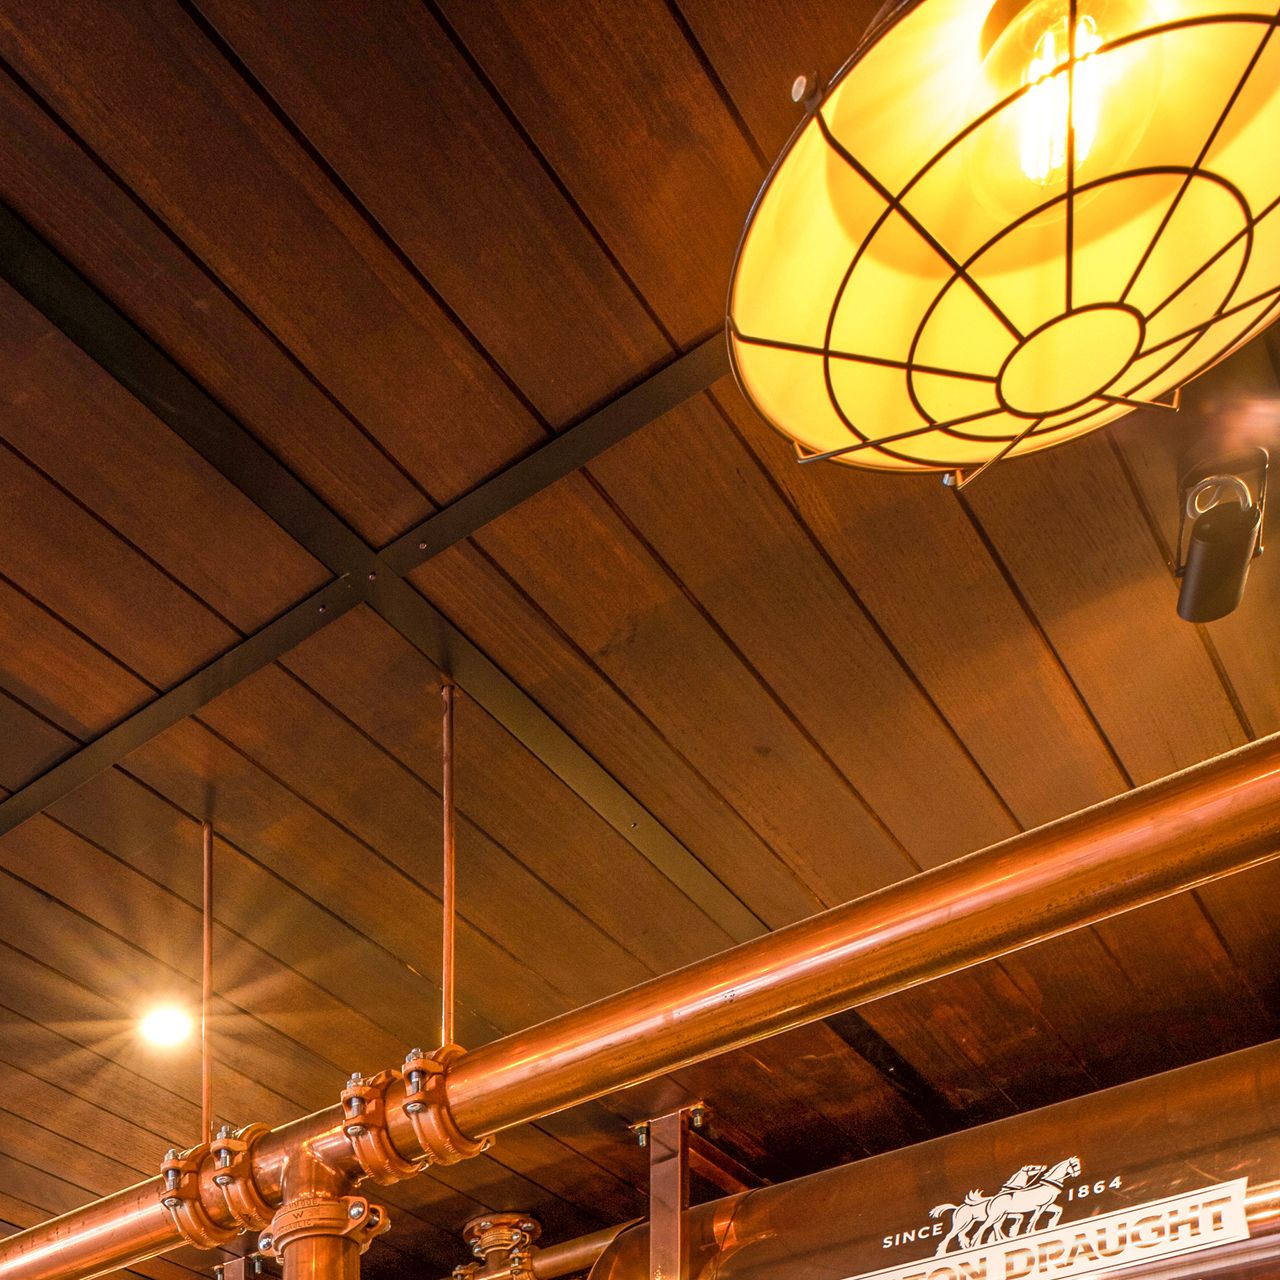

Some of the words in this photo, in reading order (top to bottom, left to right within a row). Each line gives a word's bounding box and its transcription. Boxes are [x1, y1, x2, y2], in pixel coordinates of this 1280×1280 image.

[1068, 1176, 1122, 1201] 1864
[882, 1223, 943, 1249] SINCE
[1004, 1196, 1233, 1280] DRAUGHT
